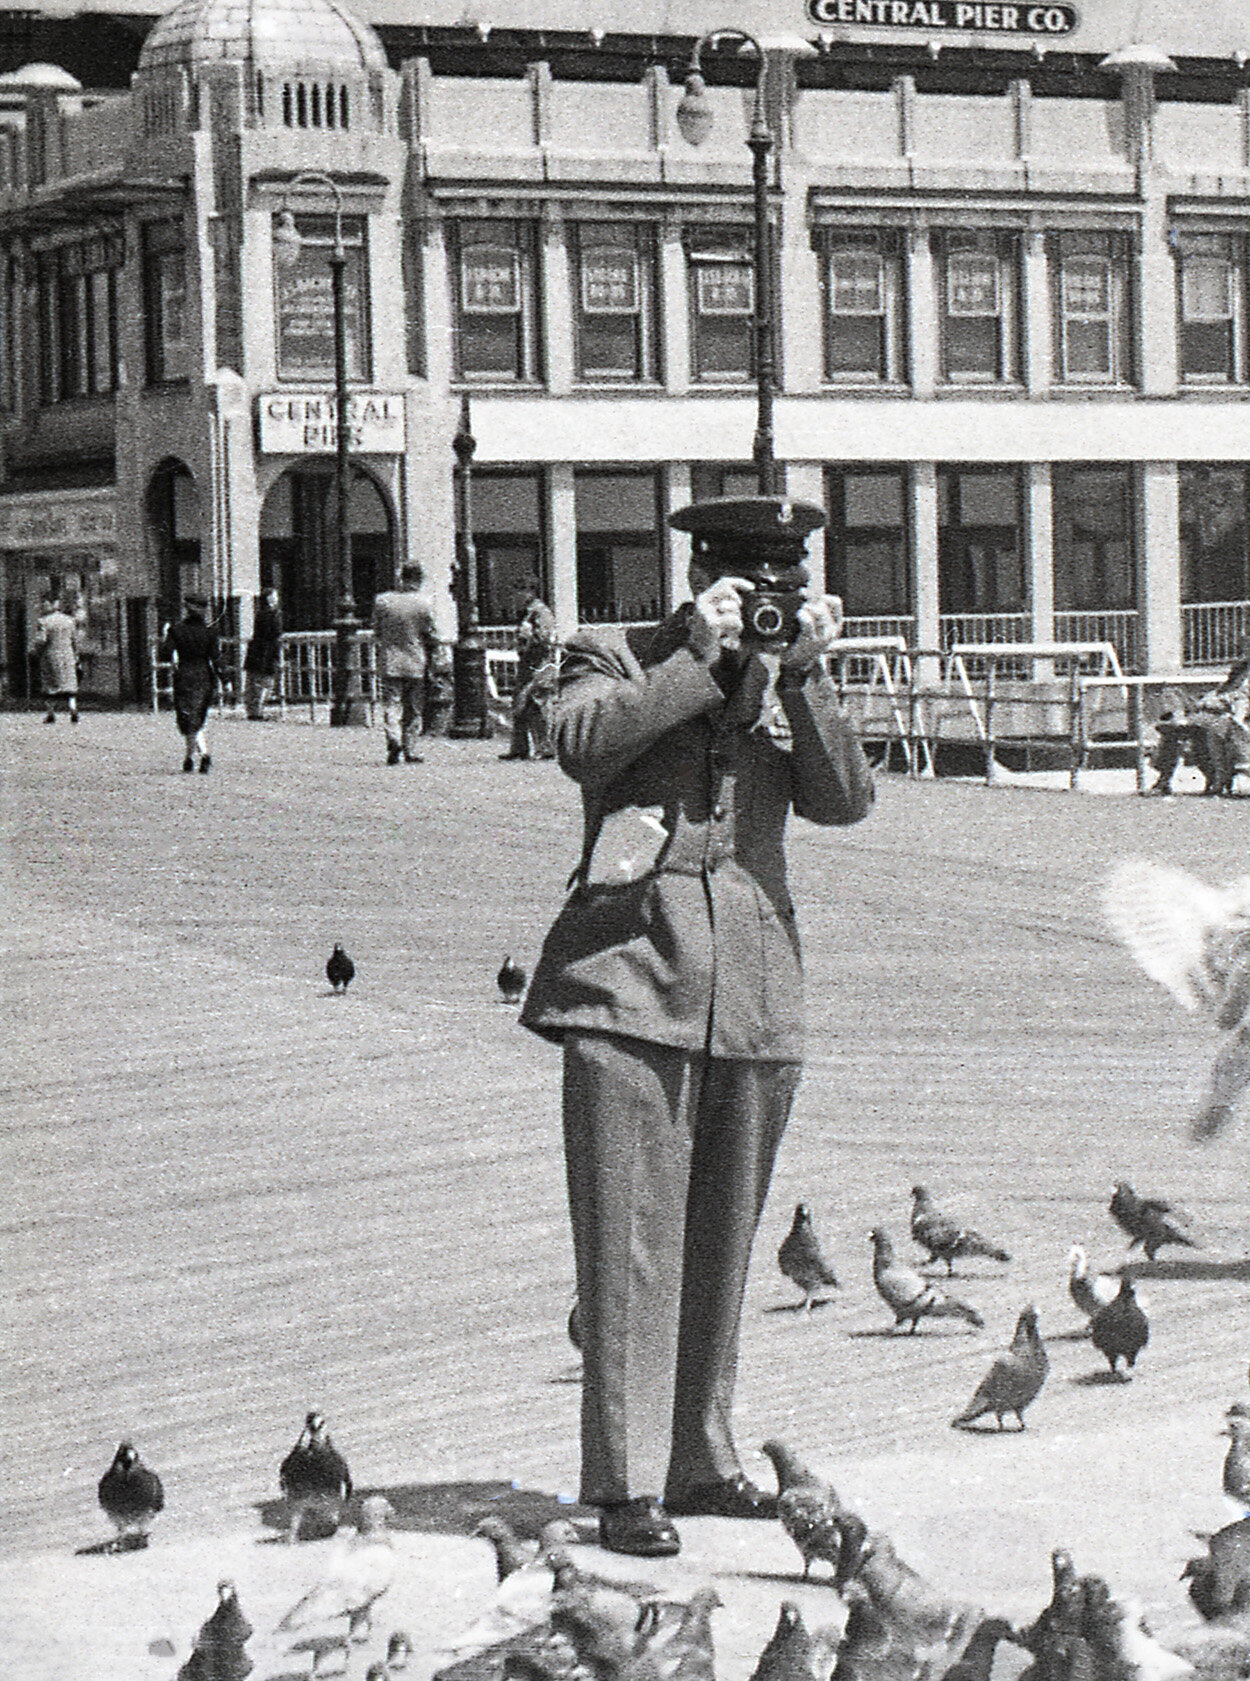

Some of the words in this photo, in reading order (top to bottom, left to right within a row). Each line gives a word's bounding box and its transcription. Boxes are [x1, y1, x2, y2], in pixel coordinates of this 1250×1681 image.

[817, 0, 946, 25] CENTRAL
[956, 5, 1018, 29] PIER
[1027, 8, 1070, 31] CO.
